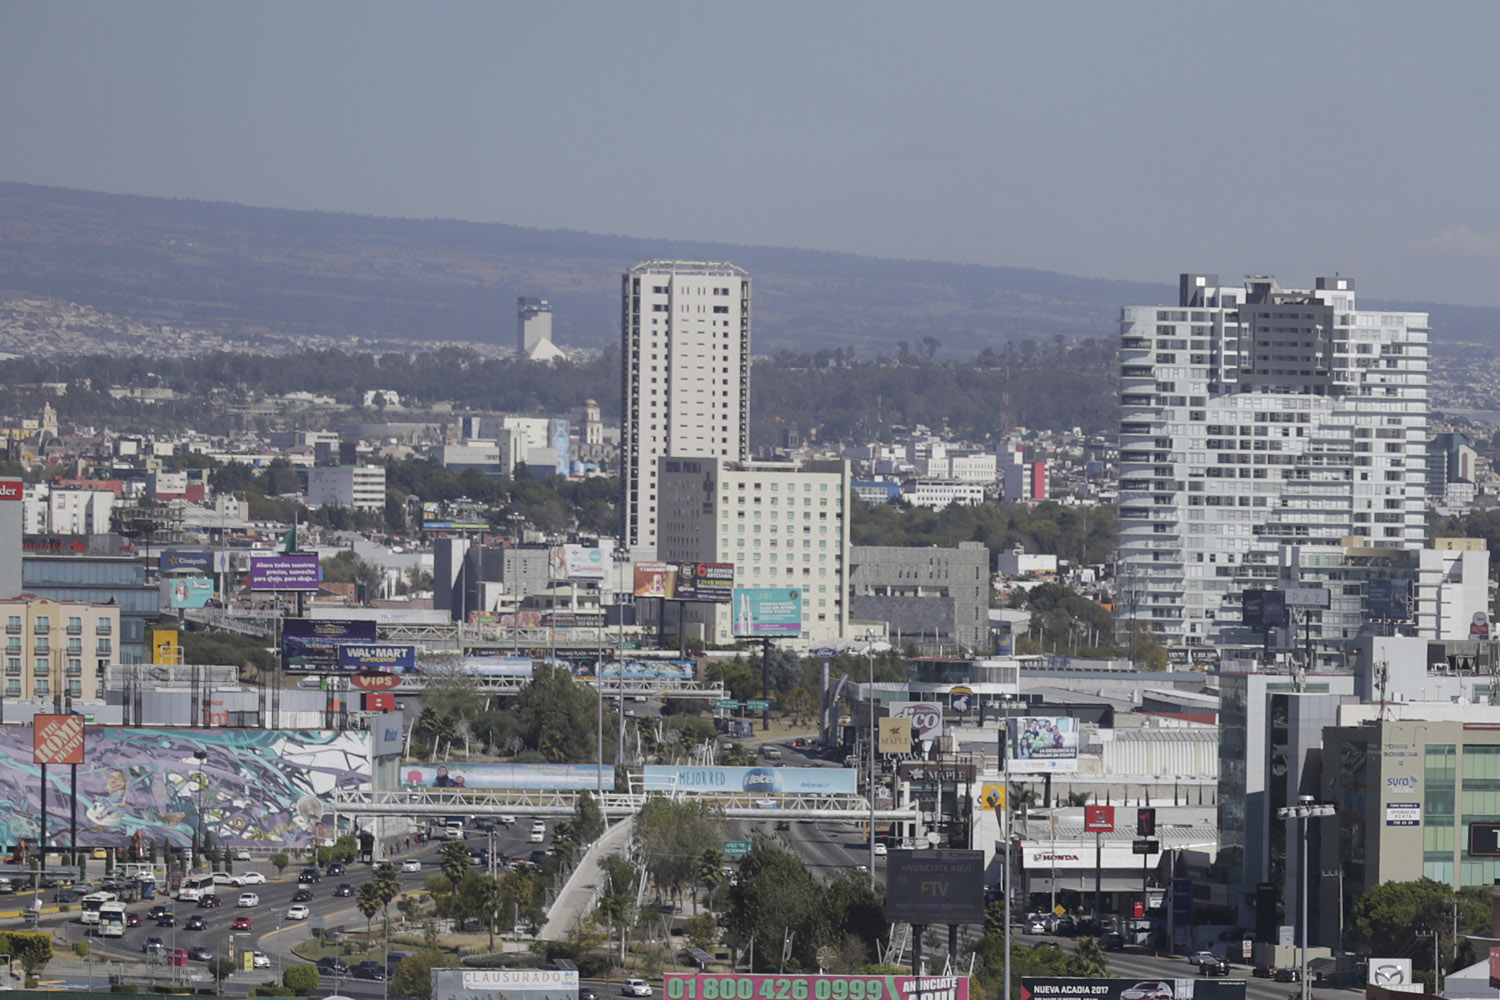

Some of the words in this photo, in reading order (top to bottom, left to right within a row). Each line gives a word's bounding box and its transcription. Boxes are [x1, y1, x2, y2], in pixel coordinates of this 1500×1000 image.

[697, 563, 707, 577] 6
[360, 676, 393, 687] VIPS
[40, 717, 62, 740] THE
[34, 714, 85, 764] HOME
[54, 733, 84, 764] DEPOT
[679, 771, 707, 786] MEJOR
[709, 772, 726, 786] RED
[1387, 777, 1409, 786] sura
[921, 881, 949, 897] FTV
[463, 972, 561, 982] CLAUSURADO
[667, 976, 697, 1000] 01
[703, 976, 753, 1000] 800
[759, 977, 809, 1000] 426
[815, 977, 884, 1000] 0999
[1033, 985, 1060, 994] NUEVA
[1061, 986, 1090, 994] ACADIA
[1091, 986, 1109, 994] 2017
